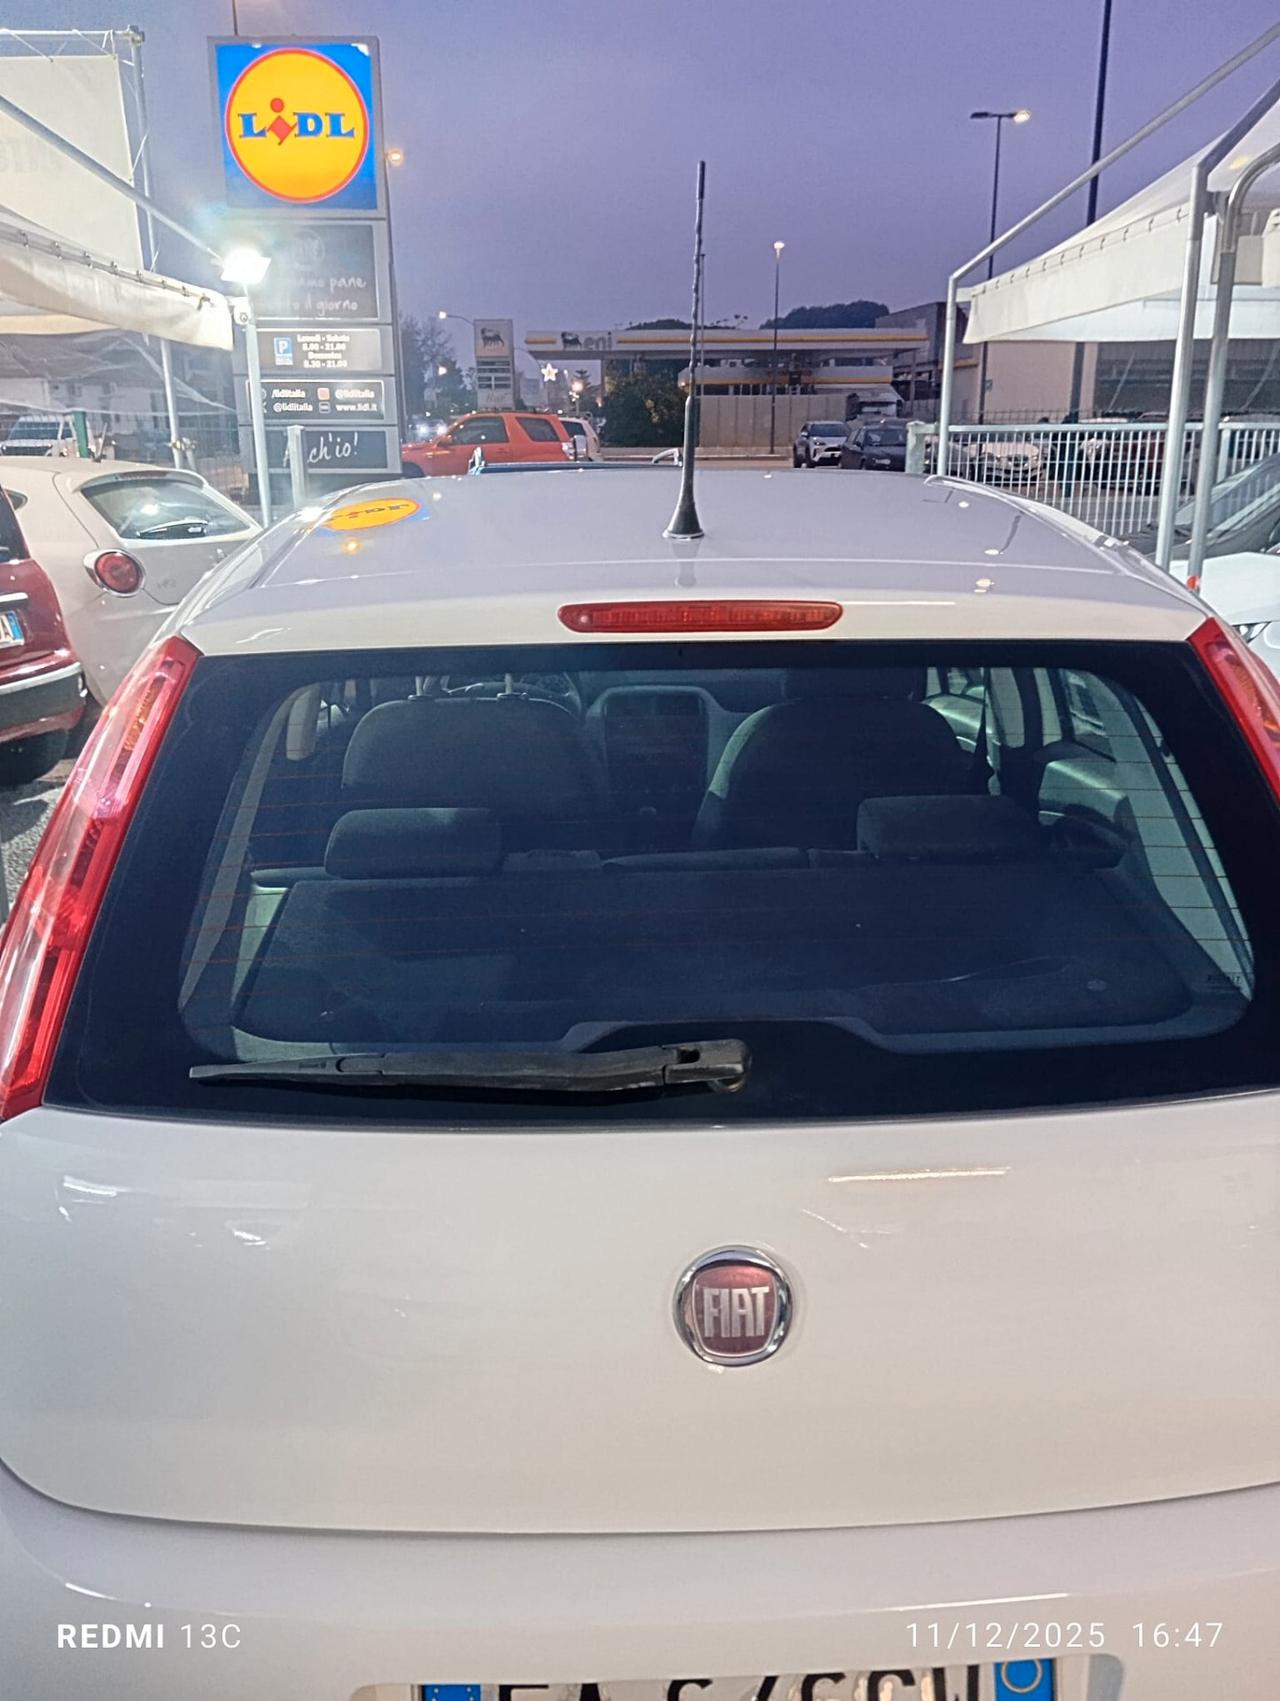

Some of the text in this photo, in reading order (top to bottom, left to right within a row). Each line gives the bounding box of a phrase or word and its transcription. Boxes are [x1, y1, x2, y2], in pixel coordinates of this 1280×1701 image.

[329, 277, 367, 294] pane
[316, 298, 358, 317] giorno
[583, 331, 613, 350] eni
[335, 403, 378, 412] www.lidl.it
[703, 1286, 770, 1338] FIAT
